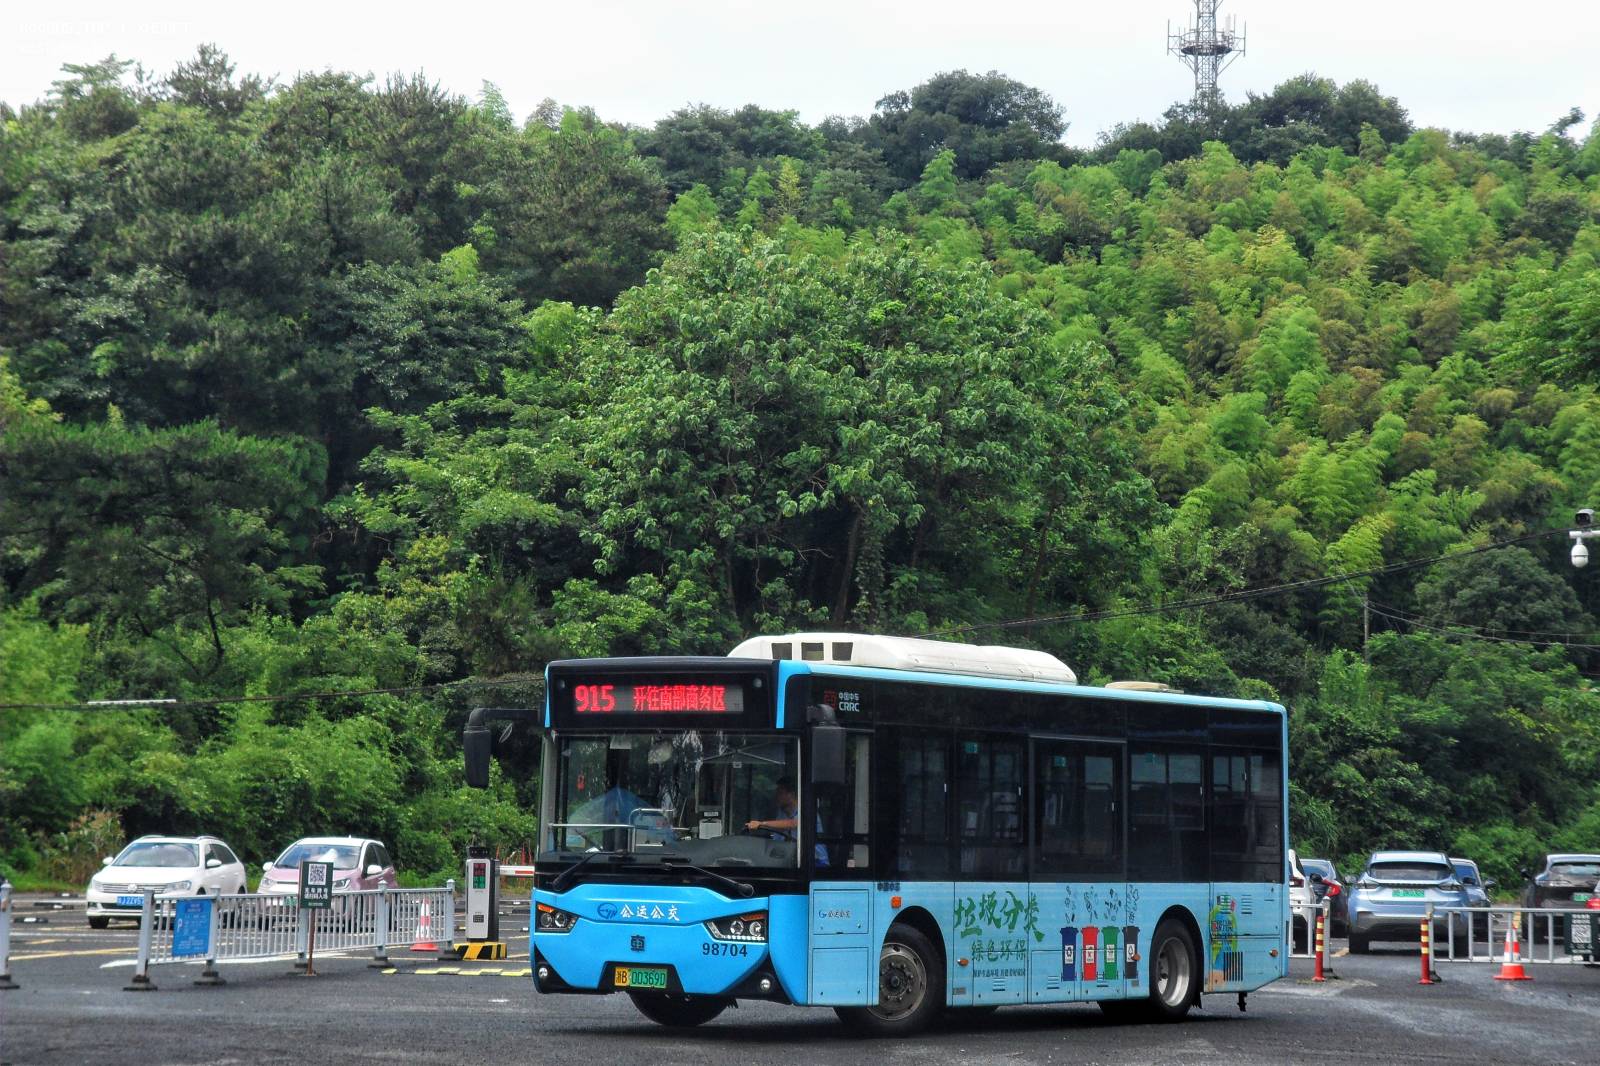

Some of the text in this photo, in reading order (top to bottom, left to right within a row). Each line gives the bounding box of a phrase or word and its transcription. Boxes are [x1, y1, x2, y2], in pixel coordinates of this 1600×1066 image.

[575, 685, 726, 711] 915 开往南部商务区
[838, 701, 860, 712] CRRC
[620, 904, 680, 921] 公运公交
[954, 890, 1045, 942] 垃圾分类
[702, 942, 748, 957] 98704
[972, 939, 1026, 961] 绿色环保
